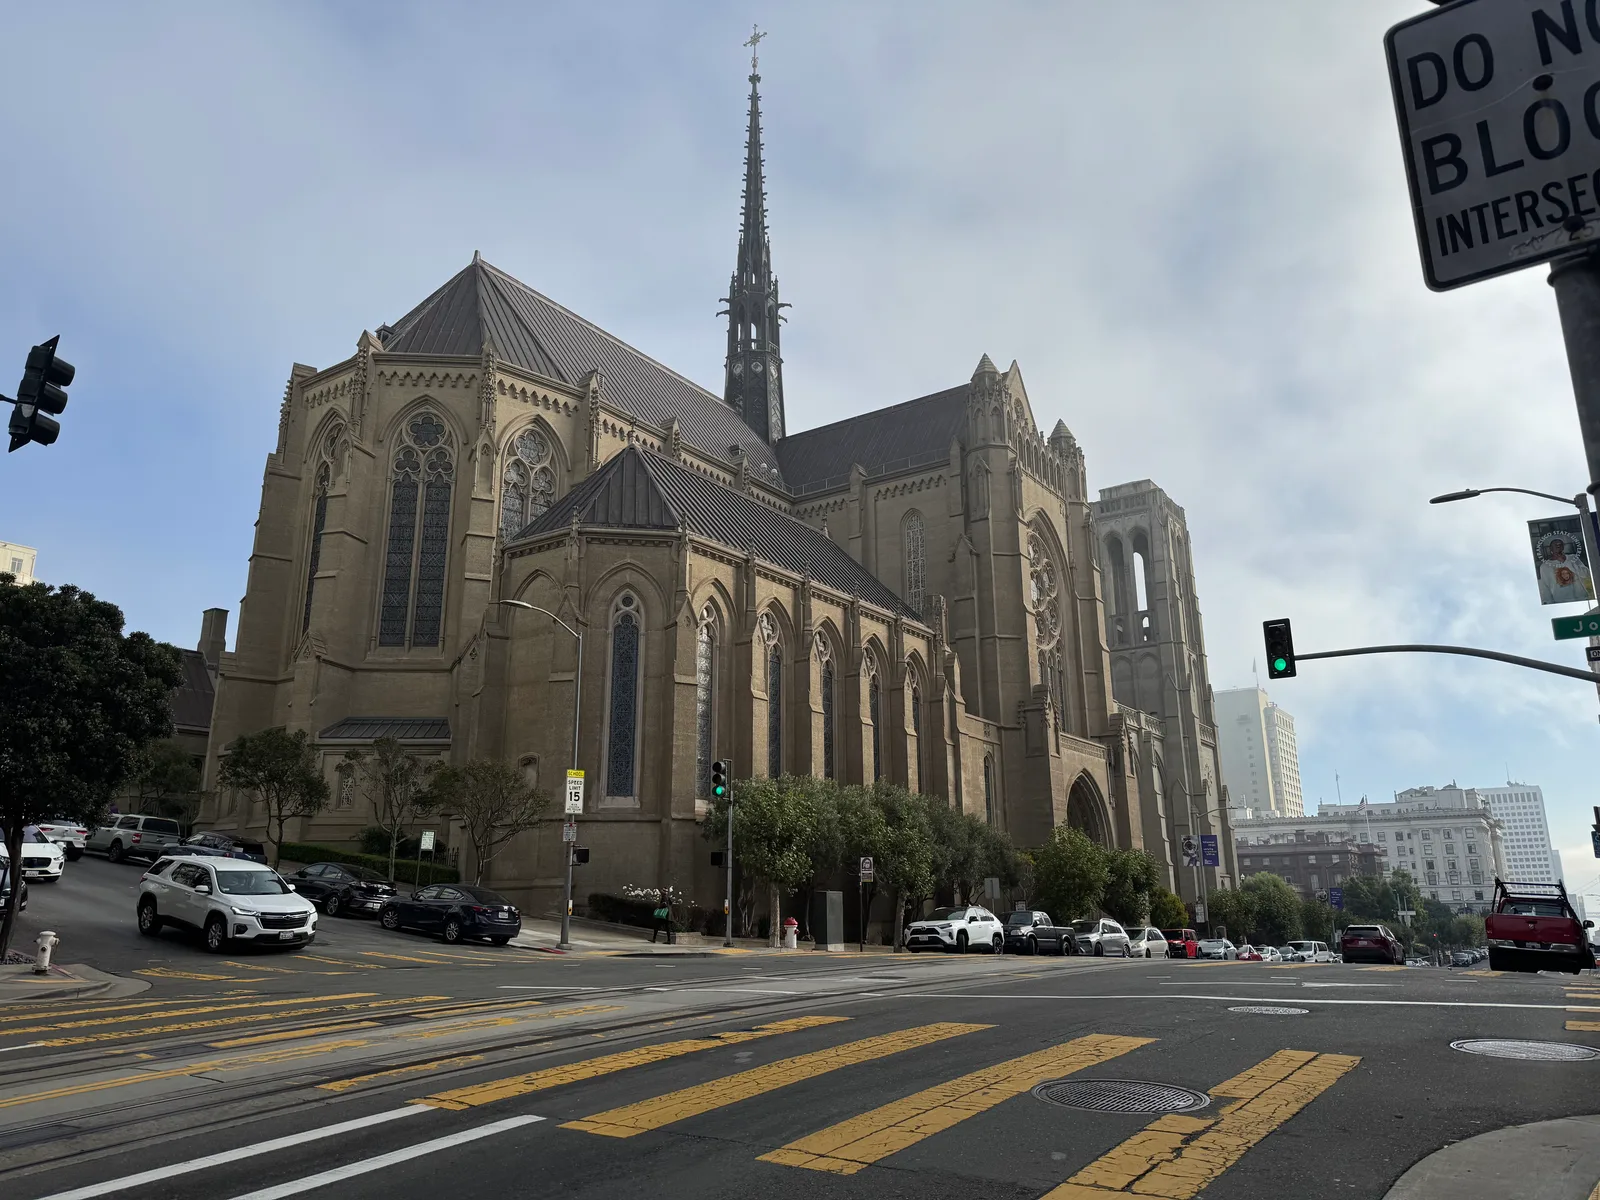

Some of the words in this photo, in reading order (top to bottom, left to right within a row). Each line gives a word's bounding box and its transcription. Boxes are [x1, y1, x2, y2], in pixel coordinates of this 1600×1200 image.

[1407, 33, 1494, 110] DO
[1436, 167, 1600, 256] INTERSE
[569, 791, 580, 801] 15
